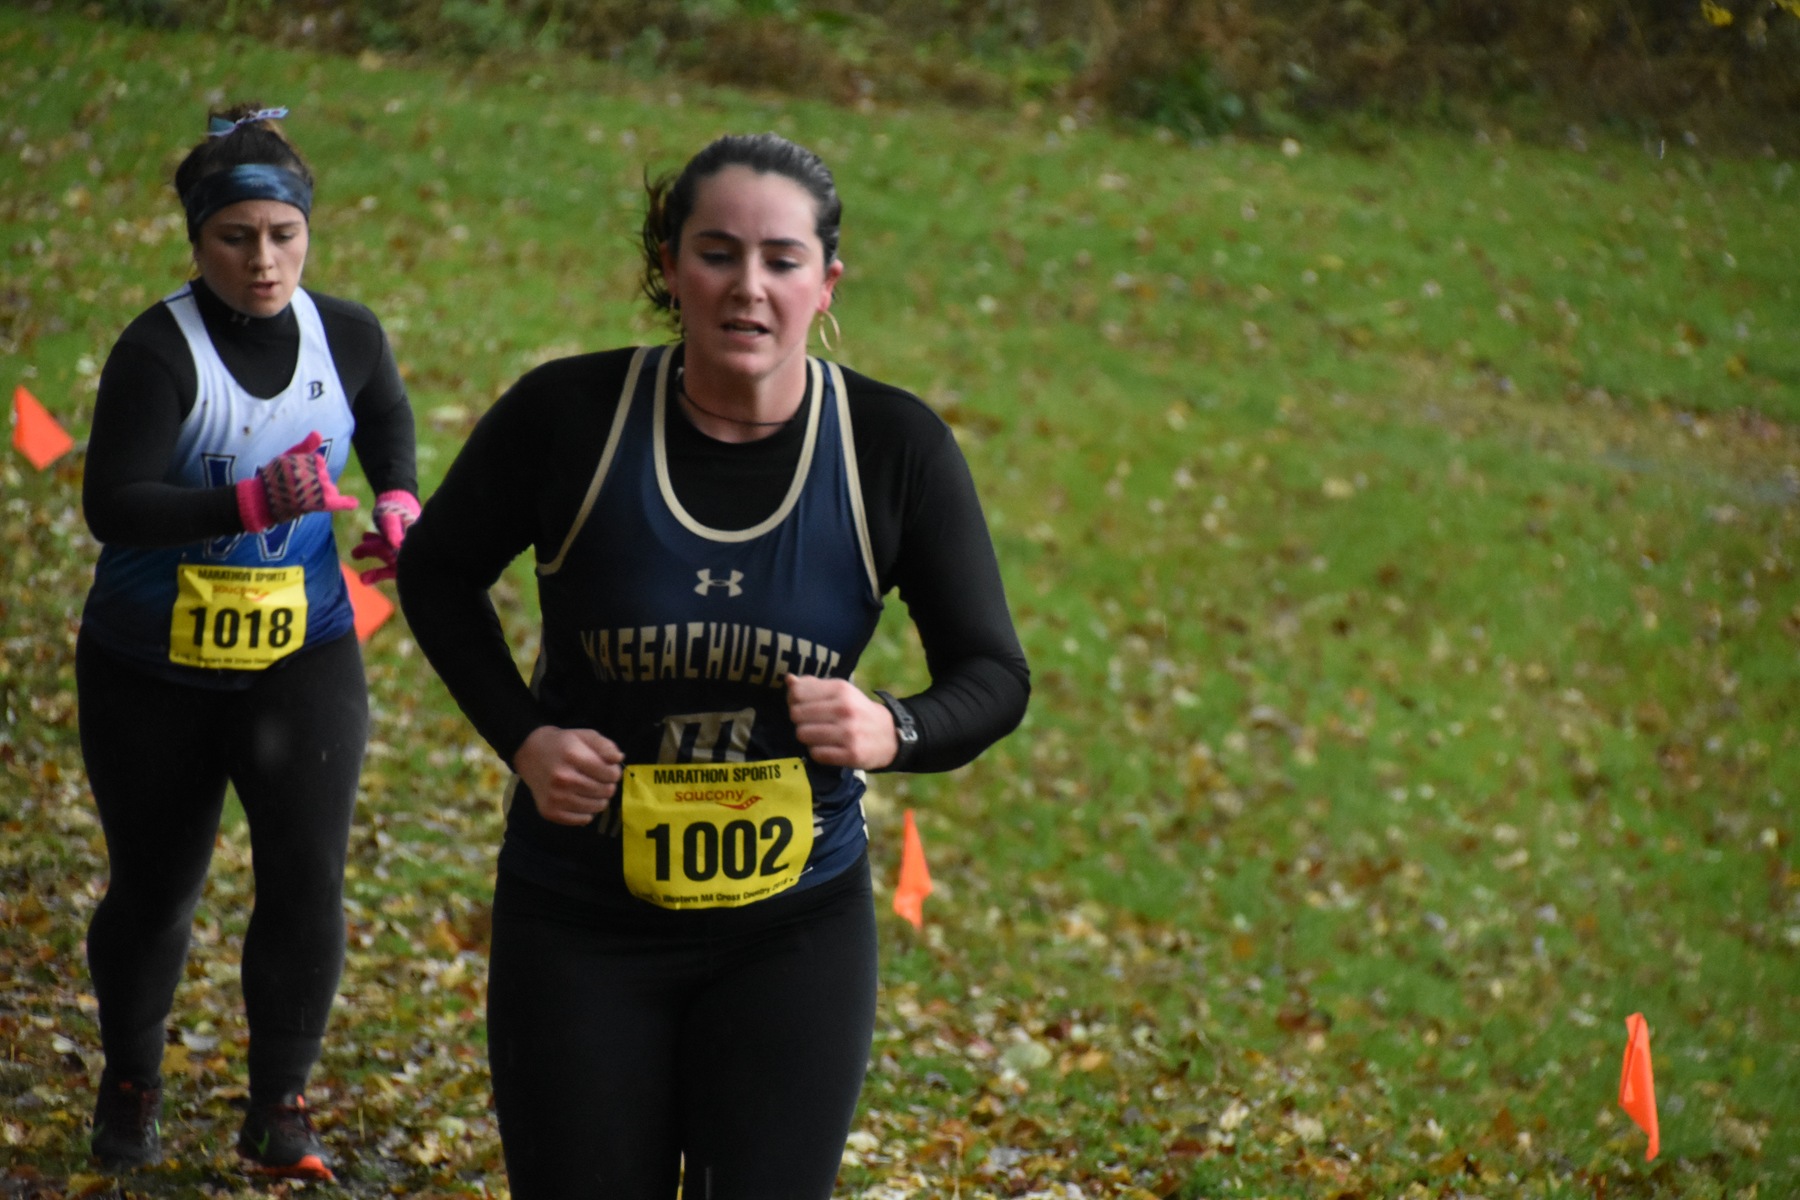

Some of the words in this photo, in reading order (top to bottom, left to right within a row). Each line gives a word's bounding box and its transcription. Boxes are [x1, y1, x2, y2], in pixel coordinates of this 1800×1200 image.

[197, 569, 252, 582] MARATHON
[254, 571, 287, 582] SPORTS
[189, 606, 293, 649] 1018
[653, 768, 728, 784] MARATHON
[733, 764, 781, 782] SPORTS
[674, 789, 745, 803] saucony
[645, 816, 793, 882] 1002
[662, 894, 699, 903] Western
[700, 893, 714, 902] MA
[716, 892, 740, 902] Cross
[743, 887, 770, 900] Country
